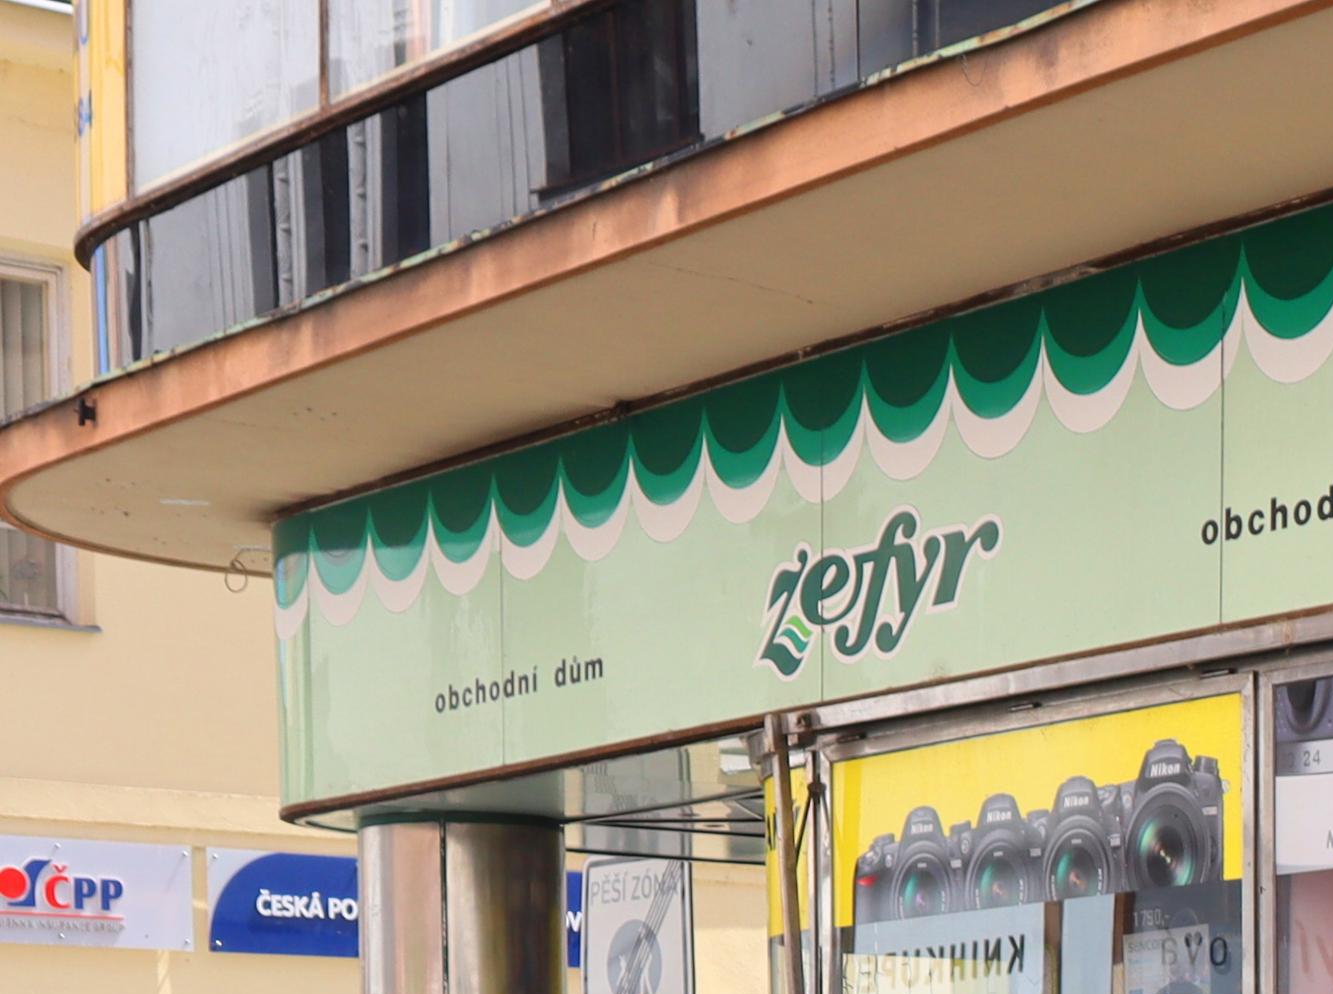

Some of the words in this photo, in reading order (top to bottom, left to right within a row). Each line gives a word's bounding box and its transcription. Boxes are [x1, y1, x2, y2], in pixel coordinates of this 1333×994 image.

[433, 664, 539, 715] obchodní
[553, 654, 604, 689] dům
[1150, 761, 1181, 778] Nikon
[986, 809, 1012, 823] Nikon
[1063, 795, 1090, 809] Nikon
[45, 864, 124, 912] ČPP
[590, 869, 628, 905] PĚŠÍ
[255, 889, 325, 920] ČESKÁ
